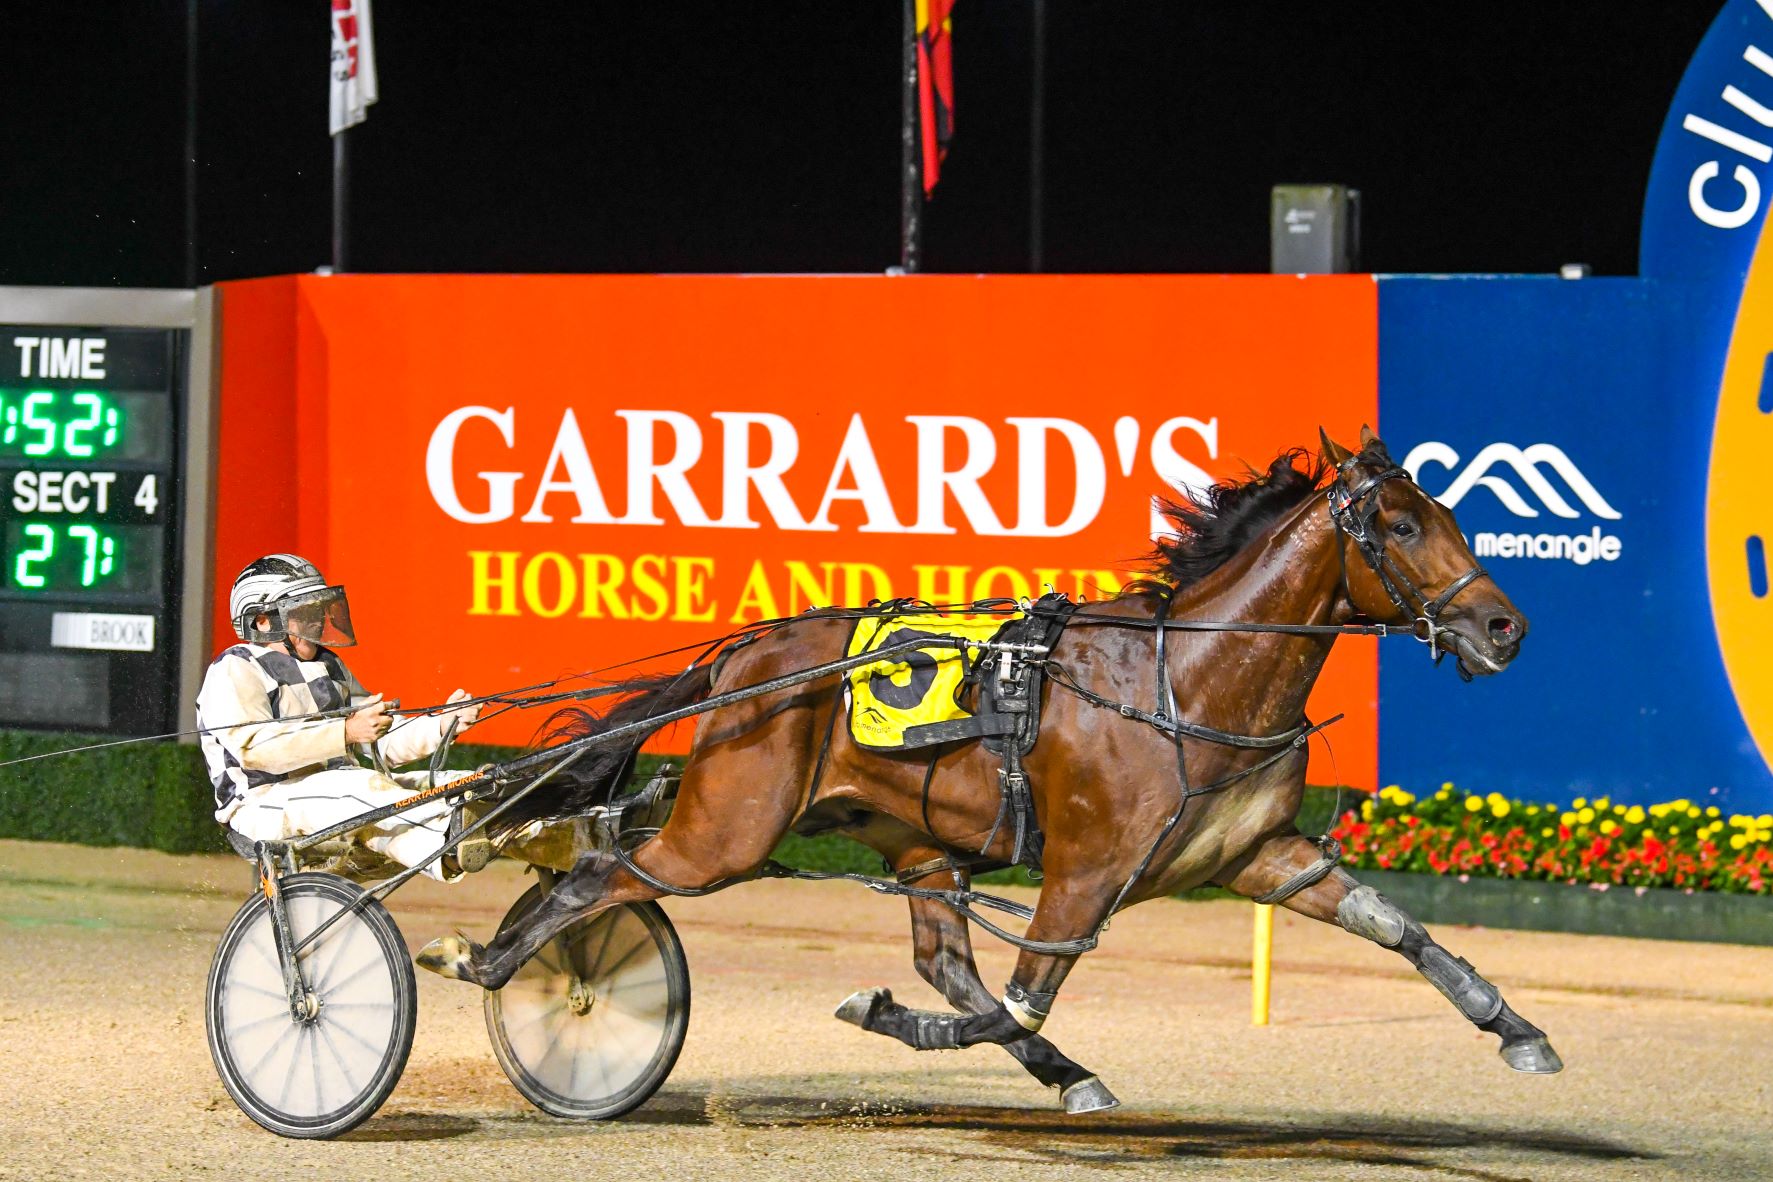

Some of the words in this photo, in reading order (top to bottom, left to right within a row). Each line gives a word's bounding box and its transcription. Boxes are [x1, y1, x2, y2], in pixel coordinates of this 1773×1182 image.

[14, 337, 107, 379] TIME
[13, 471, 116, 514] SECT
[134, 474, 158, 515] 4
[426, 406, 1218, 543] GARRARD'S
[1475, 525, 1622, 566] menangle
[468, 551, 715, 622] HORSE
[731, 560, 893, 625] AND
[912, 563, 1168, 620] HOUN
[447, 770, 484, 790] MORRIS
